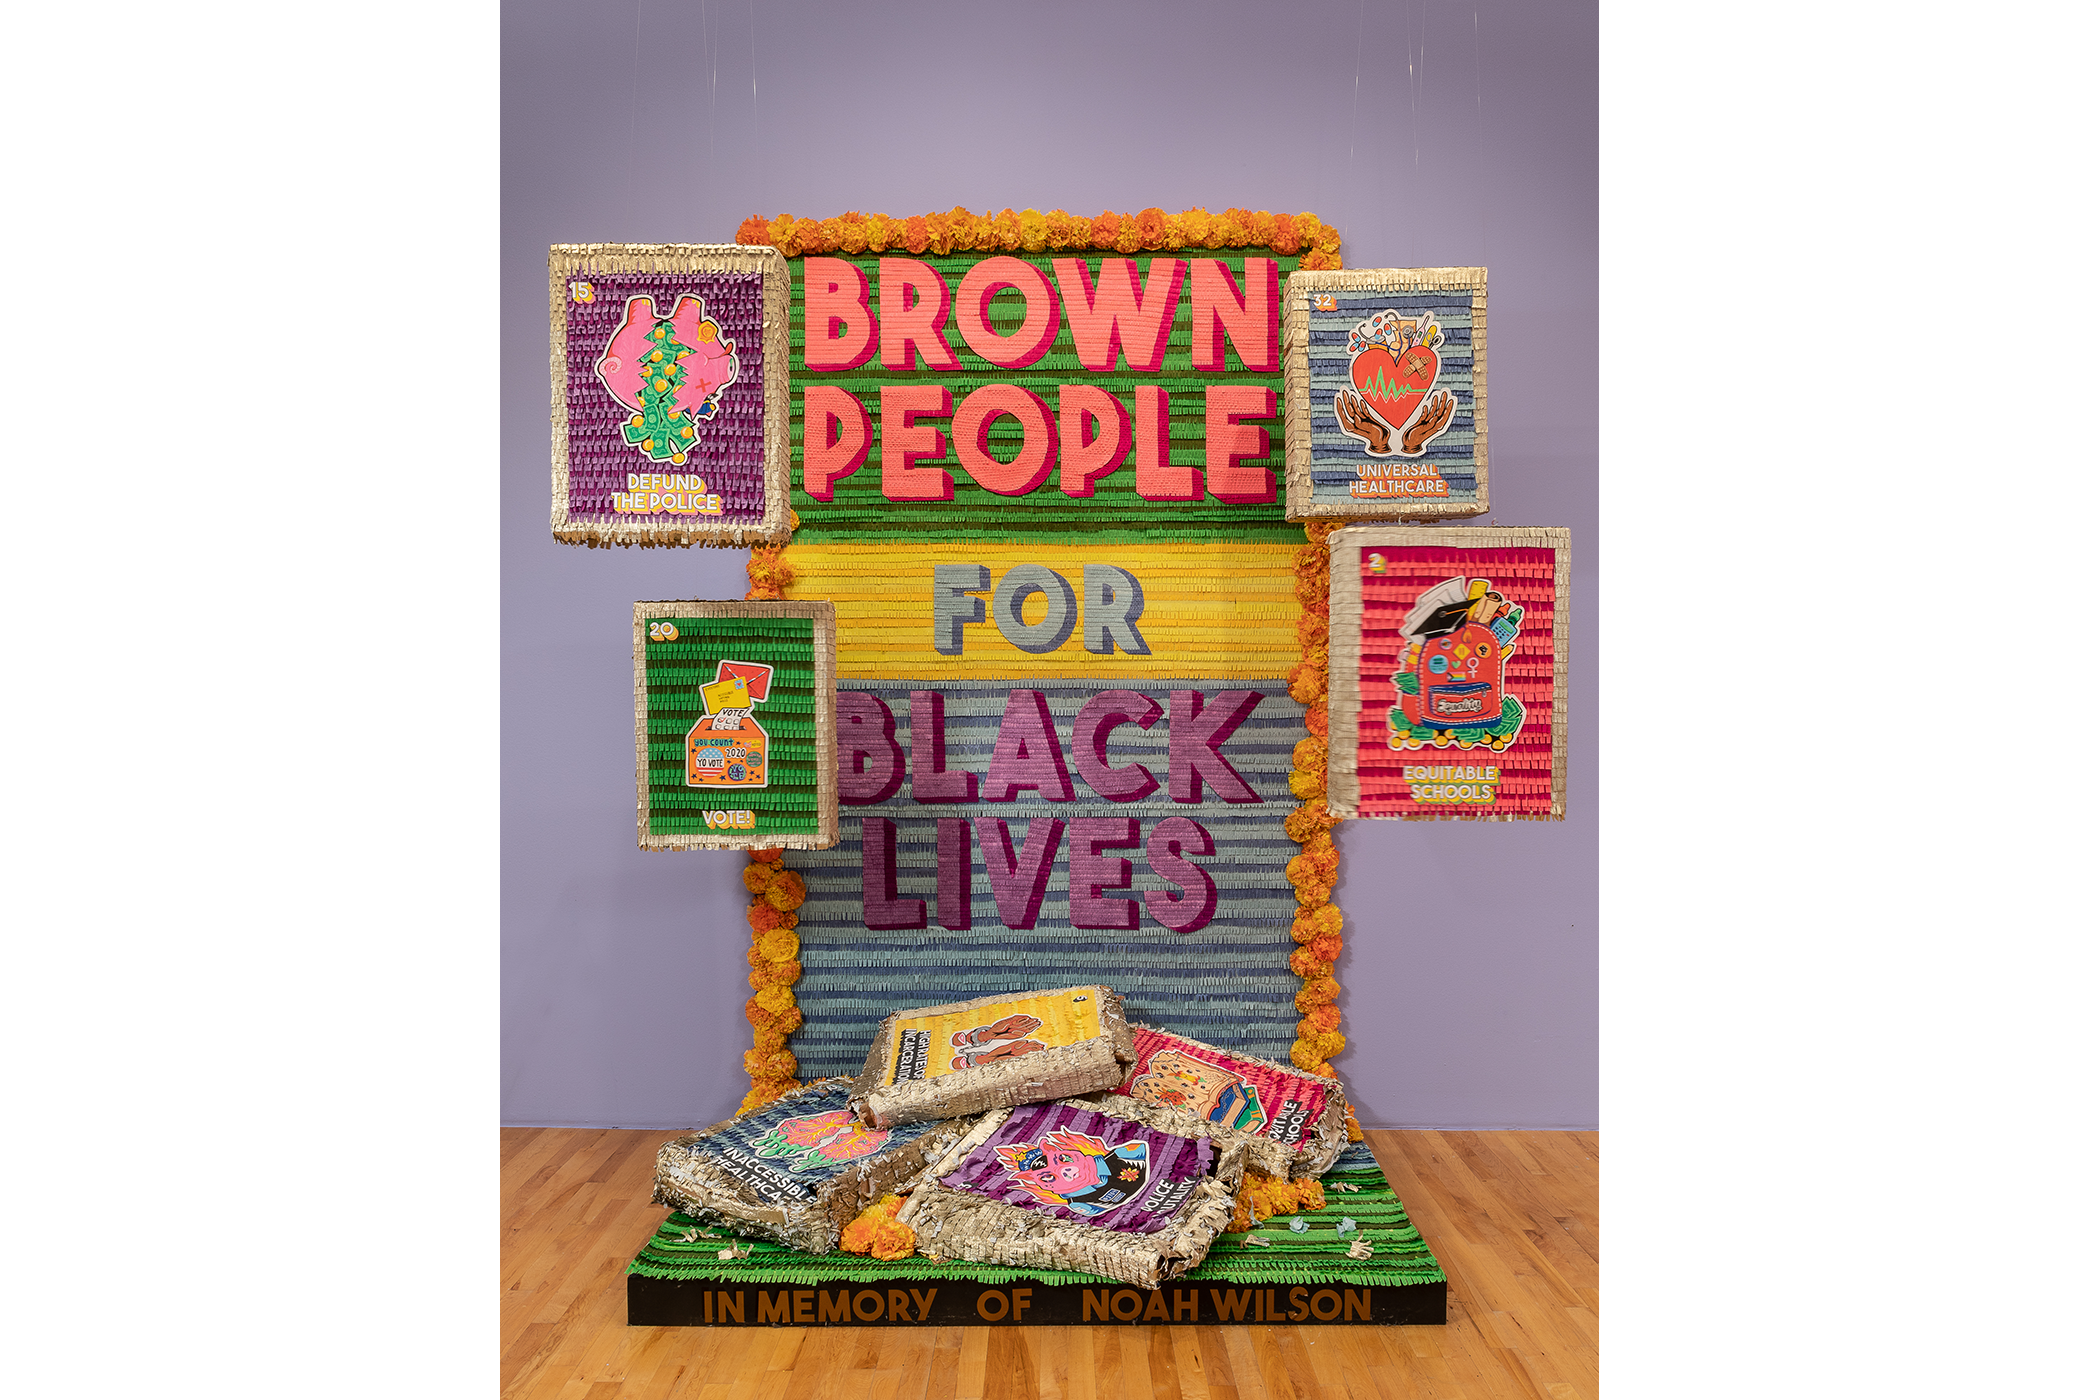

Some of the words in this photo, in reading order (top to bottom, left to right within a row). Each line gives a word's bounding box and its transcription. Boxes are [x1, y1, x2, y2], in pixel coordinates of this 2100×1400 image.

[569, 281, 592, 301] 15
[1313, 294, 1334, 309] 32
[804, 255, 1280, 372] BROWN
[803, 383, 1277, 504] PEOPLE
[1356, 463, 1439, 479] UNIVERSAL
[628, 473, 704, 493] DEFUND
[1349, 480, 1447, 496] HEALTHCARE
[611, 491, 647, 511] THE
[650, 493, 721, 512] POLICE
[1368, 553, 1384, 571] 2
[933, 563, 1151, 655] FOR
[650, 622, 676, 639] 20
[725, 747, 746, 758] 2020
[836, 689, 1265, 804] BLACK
[708, 758, 723, 768] VOTE
[1403, 765, 1498, 783] EQUITABLE
[1411, 784, 1493, 801] SCHOOLS
[702, 810, 753, 827] VOTE!
[862, 816, 1217, 934] LIVES
[917, 1029, 931, 1049] HIGH
[914, 1048, 929, 1070] RATES
[716, 1155, 783, 1201] HEALTHCA
[1140, 1178, 1175, 1212] POLICE
[703, 1290, 745, 1324] IN
[757, 1288, 938, 1323] MEMORY
[976, 1288, 1033, 1322] OF
[1082, 1288, 1199, 1322] NOAH
[1210, 1286, 1371, 1322] WILSON
